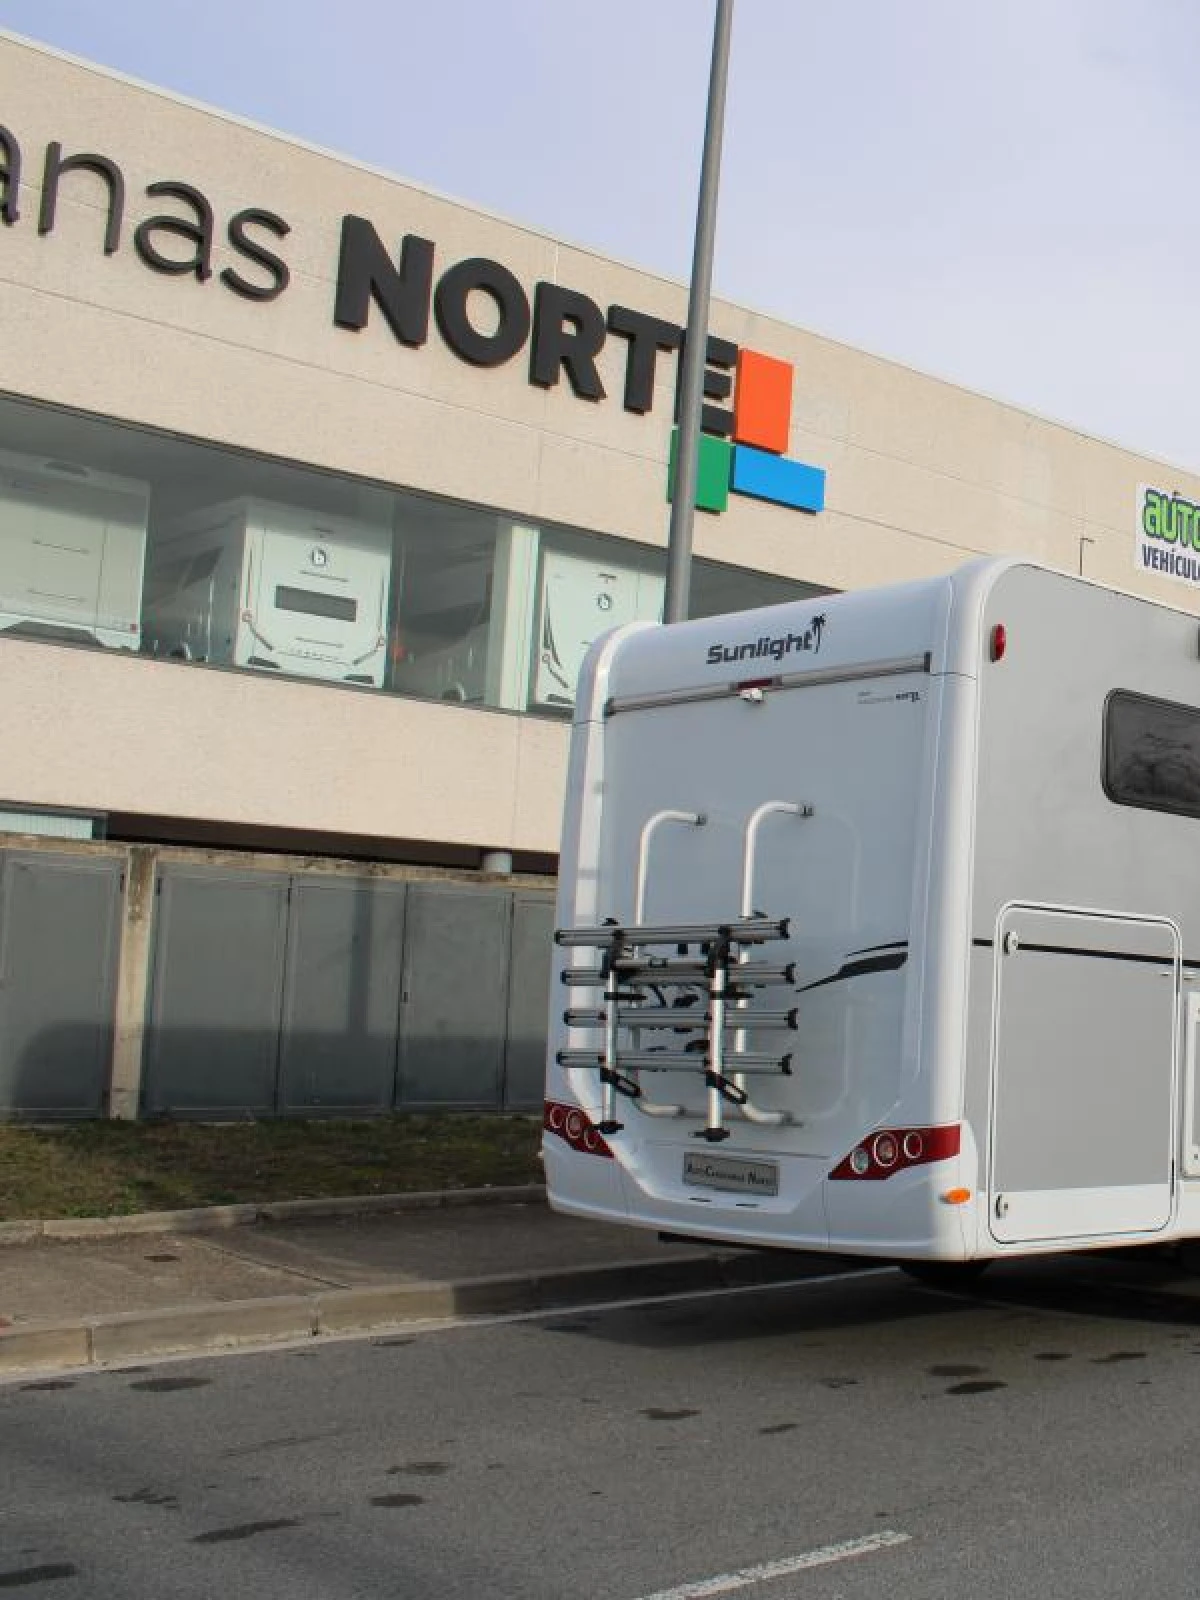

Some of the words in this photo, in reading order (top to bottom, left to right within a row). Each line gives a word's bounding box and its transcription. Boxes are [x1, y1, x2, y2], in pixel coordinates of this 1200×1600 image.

[0, 124, 291, 302] nas
[333, 213, 739, 437] NORTE
[706, 629, 814, 664] Sunlight
